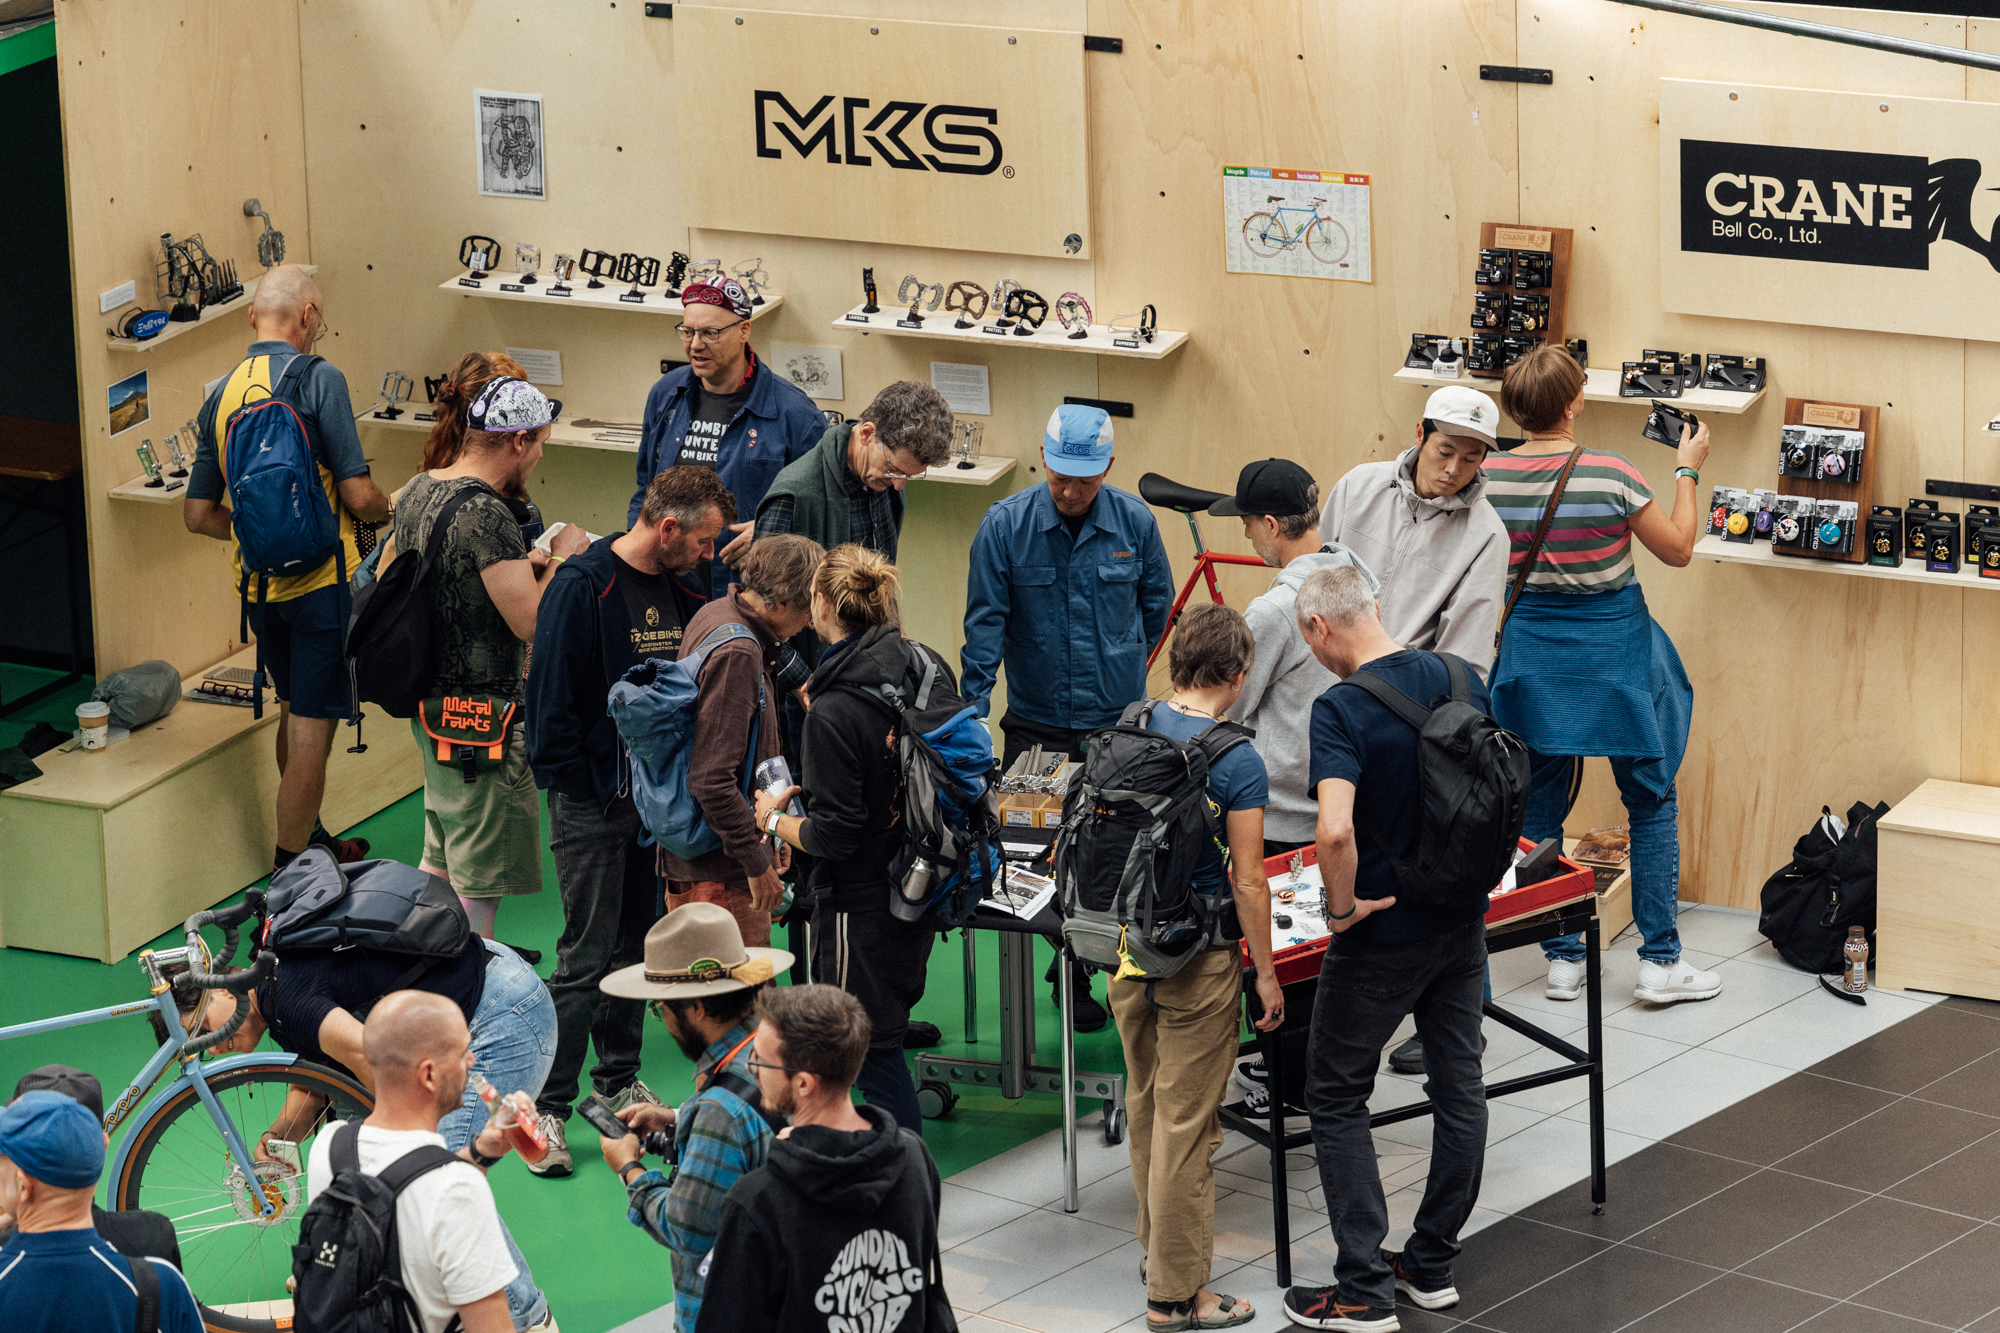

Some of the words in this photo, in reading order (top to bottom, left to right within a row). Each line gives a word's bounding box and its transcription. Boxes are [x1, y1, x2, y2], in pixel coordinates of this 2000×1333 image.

[755, 90, 1003, 176] MKS
[1705, 172, 1912, 229] CRANE
[1502, 233, 1527, 242] CRANE
[1712, 220, 1742, 238] Bell
[1748, 222, 1783, 243] Co.,
[1789, 226, 1822, 244] Ltd.
[1810, 410, 1836, 418] CRANE
[689, 420, 729, 436] OMBI
[682, 435, 719, 451] UNTE
[1062, 442, 1091, 456] MKS
[681, 449, 696, 459] ON
[696, 451, 718, 462] BIKE
[824, 1228, 912, 1283] SUNDAY
[814, 1267, 923, 1317] CYCLING
